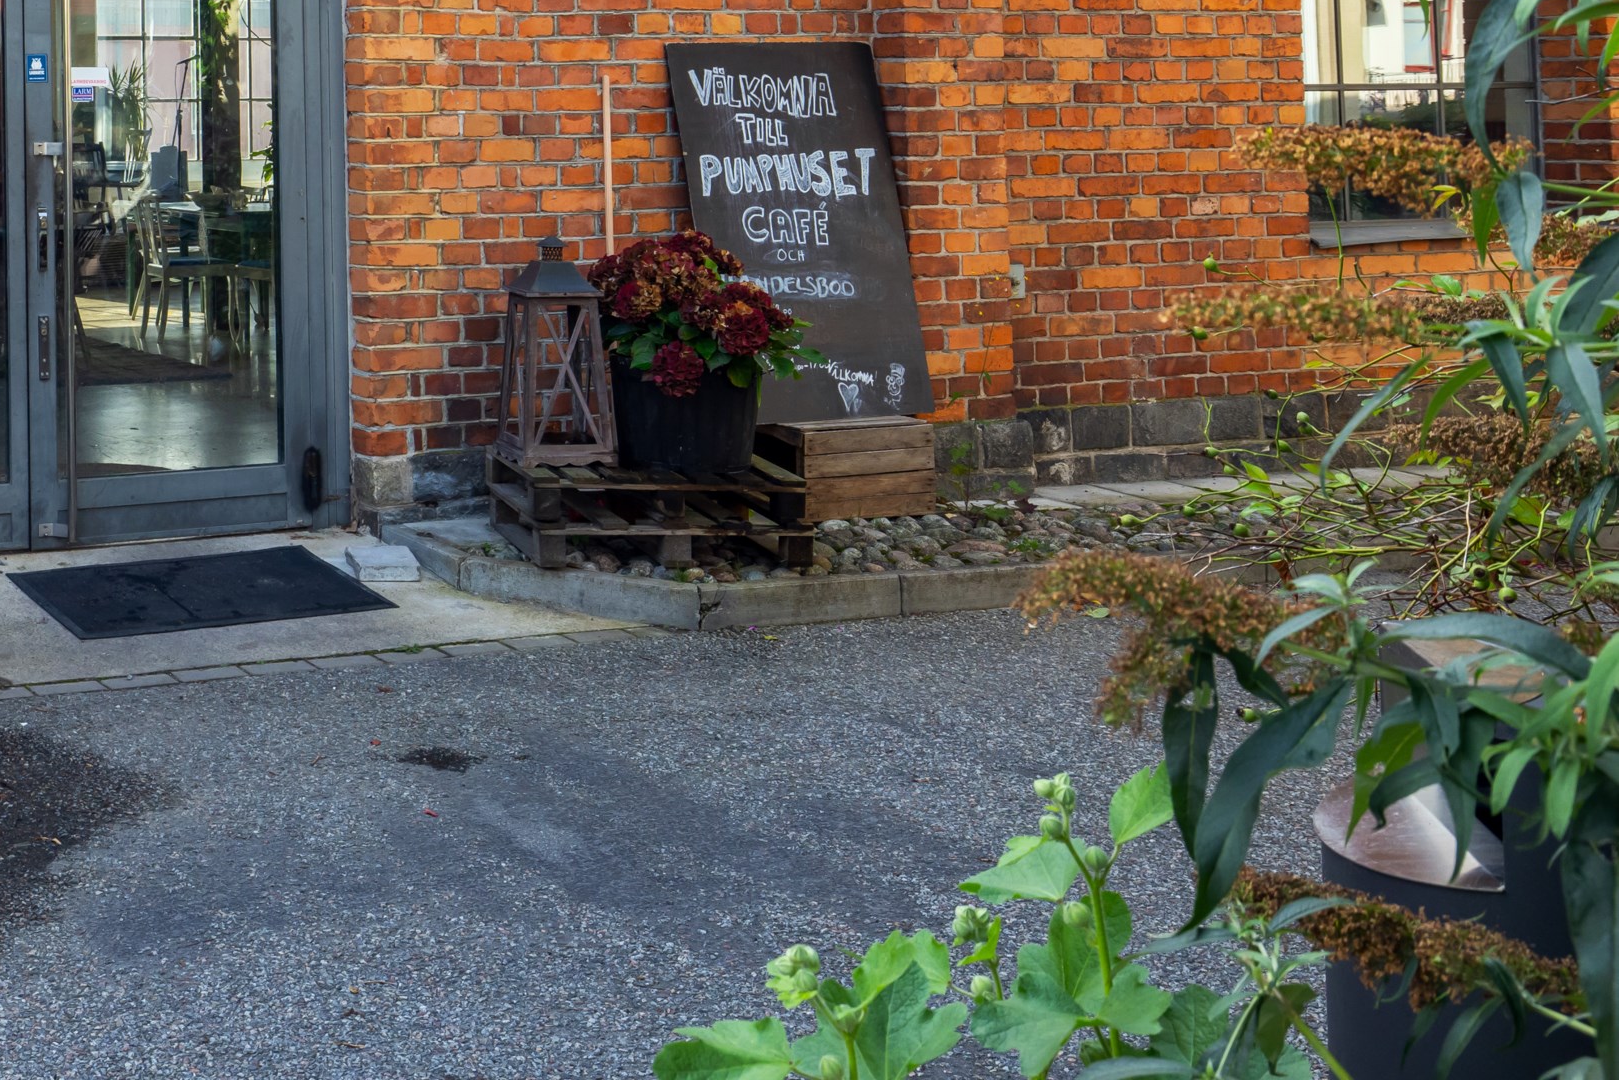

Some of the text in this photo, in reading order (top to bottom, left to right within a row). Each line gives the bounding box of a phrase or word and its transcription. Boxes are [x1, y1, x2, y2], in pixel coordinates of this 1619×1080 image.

[687, 66, 837, 118] VÄLKOMNA
[735, 113, 789, 146] TILL
[699, 148, 876, 201] PUMPHUSET
[742, 201, 829, 246] CAFÉ
[777, 248, 805, 262] OCH
